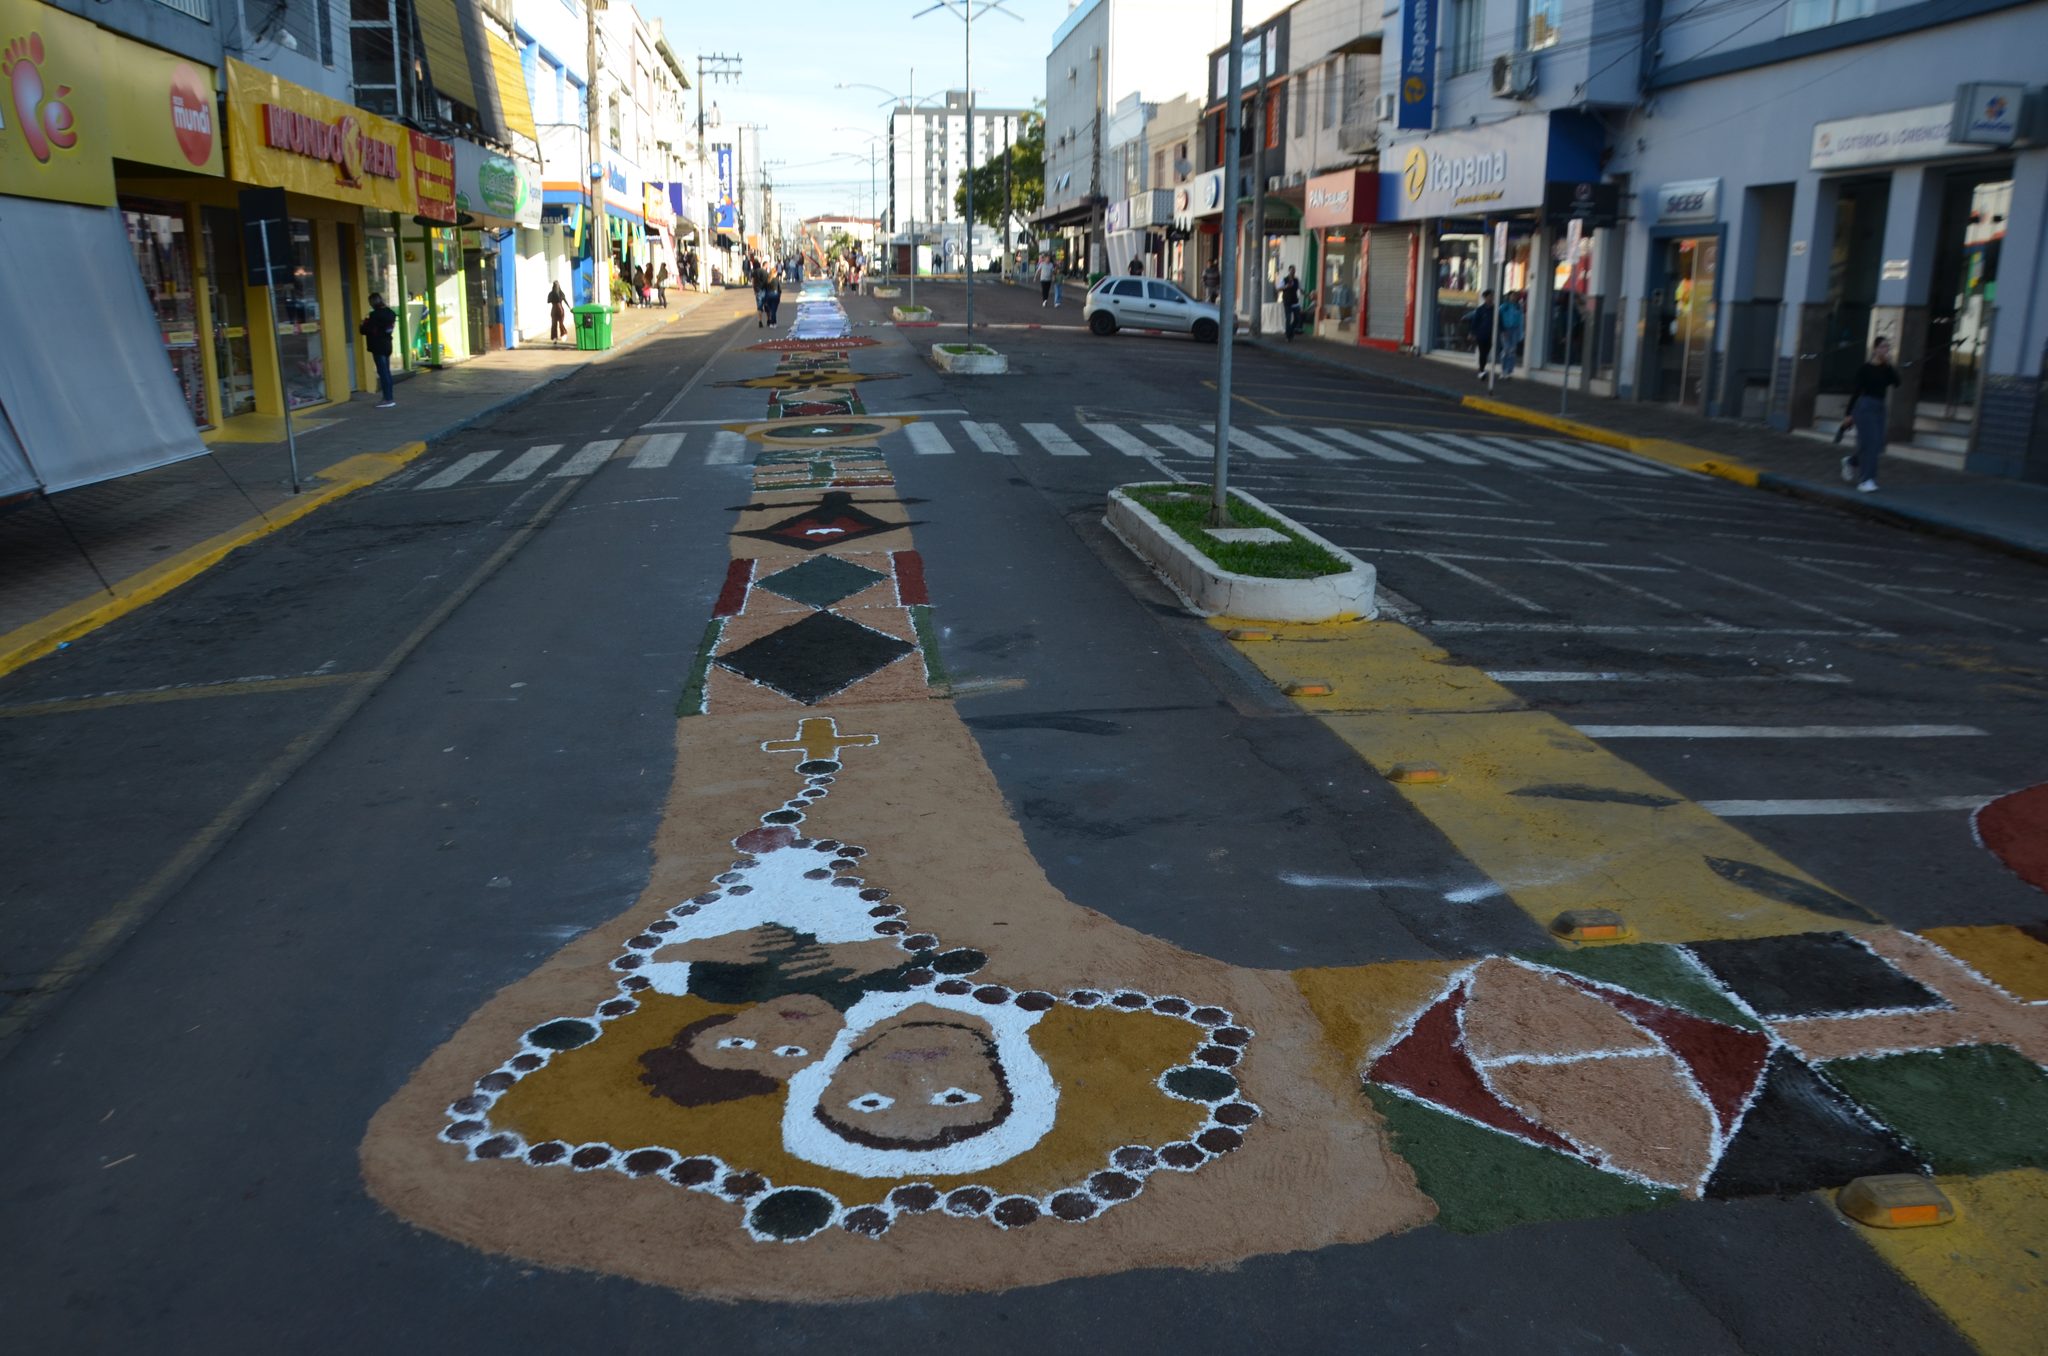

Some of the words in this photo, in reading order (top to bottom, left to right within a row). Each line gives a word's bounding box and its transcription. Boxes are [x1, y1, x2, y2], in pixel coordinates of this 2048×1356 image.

[173, 103, 211, 135] mundi
[264, 103, 343, 165] MUNDO
[1430, 151, 1507, 196] itapema
[541, 213, 565, 224] asul
